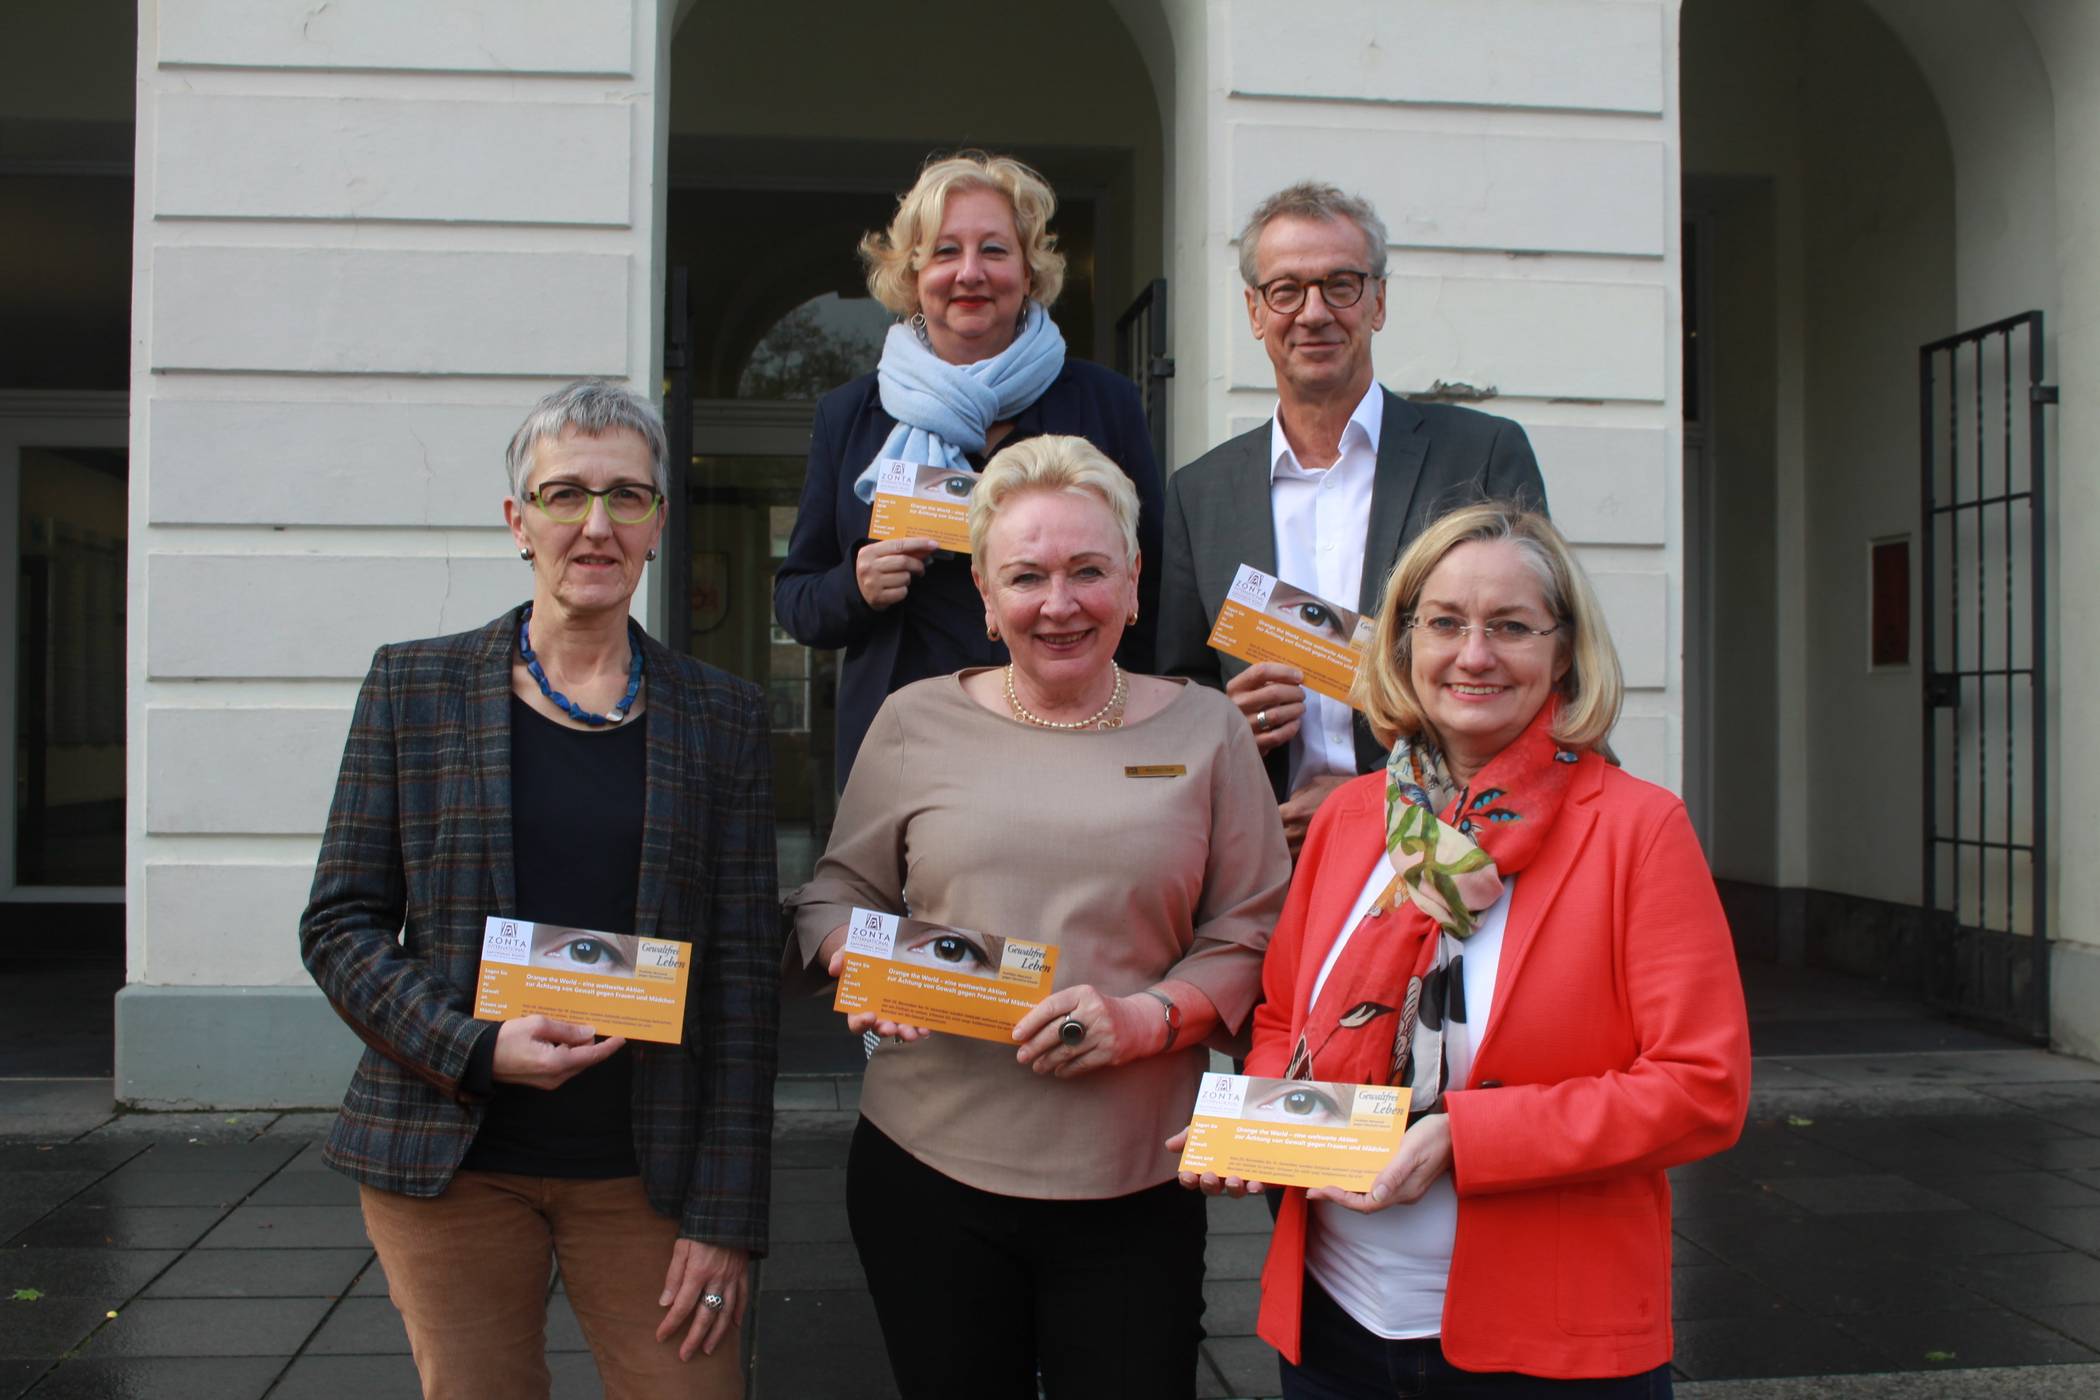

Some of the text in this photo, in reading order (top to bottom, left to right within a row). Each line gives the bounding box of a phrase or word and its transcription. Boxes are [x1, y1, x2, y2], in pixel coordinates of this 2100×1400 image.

[881, 473, 911, 482] ZONTA
[1235, 579, 1267, 597] ZONTA
[852, 927, 891, 941] ZONTA
[488, 935, 527, 948] ZONTA
[641, 942, 680, 958] Gewaltfrei
[1006, 943, 1047, 961] Gewaltfrei
[656, 955, 685, 969] Leben
[1021, 956, 1051, 973] Leben
[526, 973, 548, 982] Orange
[887, 968, 909, 978] Orange
[920, 974, 938, 983] World
[986, 987, 1006, 995] Aktion
[615, 991, 635, 999] Frauen
[648, 995, 674, 1003] Mädchen
[935, 984, 956, 993] Gewalt
[956, 990, 975, 998] gegen
[976, 992, 996, 1001] Frauen
[1201, 1090, 1241, 1101] ZONTA
[1357, 1090, 1399, 1104] Gewaltfrei
[1372, 1102, 1404, 1115] Leben
